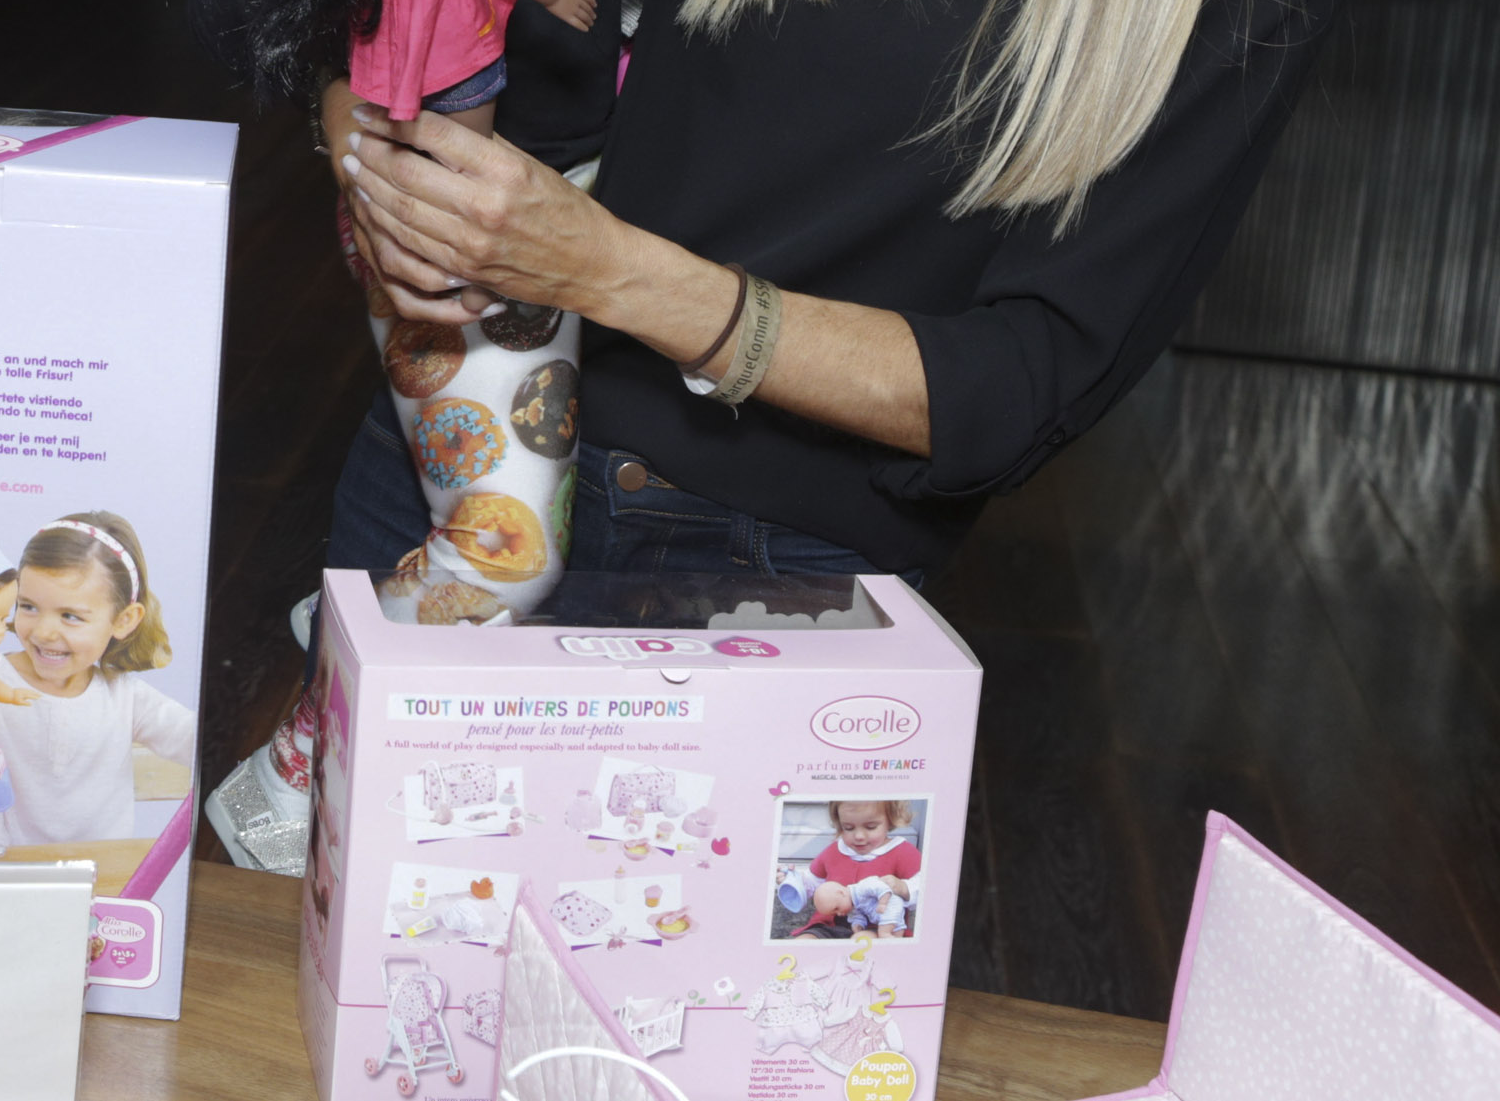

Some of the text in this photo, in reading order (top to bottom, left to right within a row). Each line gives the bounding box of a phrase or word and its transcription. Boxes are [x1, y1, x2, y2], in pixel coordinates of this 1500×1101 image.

[4, 355, 20, 365] an
[24, 356, 47, 367] und
[51, 357, 85, 370] mach
[88, 360, 109, 371] mir
[5, 367, 32, 379] tolle
[36, 368, 73, 382] Frisur!
[29, 393, 83, 408] vistiendo
[24, 407, 37, 418] tu
[40, 408, 93, 422] muñeca!
[18, 431, 30, 445] je
[34, 434, 58, 446] met
[61, 435, 80, 450] mij
[22, 446, 38, 457] en
[41, 447, 54, 458] te
[57, 448, 107, 463] kappen!
[404, 698, 453, 716] TOUT
[460, 700, 485, 717] UN
[577, 700, 601, 717] DE
[608, 700, 690, 717] POUPONS
[822, 709, 911, 734] Corolle
[466, 721, 625, 740] pensé pour les tout-petits
[384, 739, 392, 748] A
[394, 739, 410, 749] full
[412, 740, 440, 750] world
[441, 741, 453, 749] of
[453, 741, 475, 752] play
[476, 742, 518, 752] designed
[519, 742, 565, 752] especially
[567, 743, 585, 751] and
[587, 743, 625, 753] adapted
[626, 743, 636, 751] to
[637, 742, 660, 753] baby
[662, 742, 680, 751] doll
[796, 759, 927, 774] parfums D'ENFANCE
[101, 925, 143, 938] Corolle
[787, 1058, 798, 1066] 30
[860, 1059, 907, 1075] Poupon
[851, 1073, 910, 1089] Baby Doll
